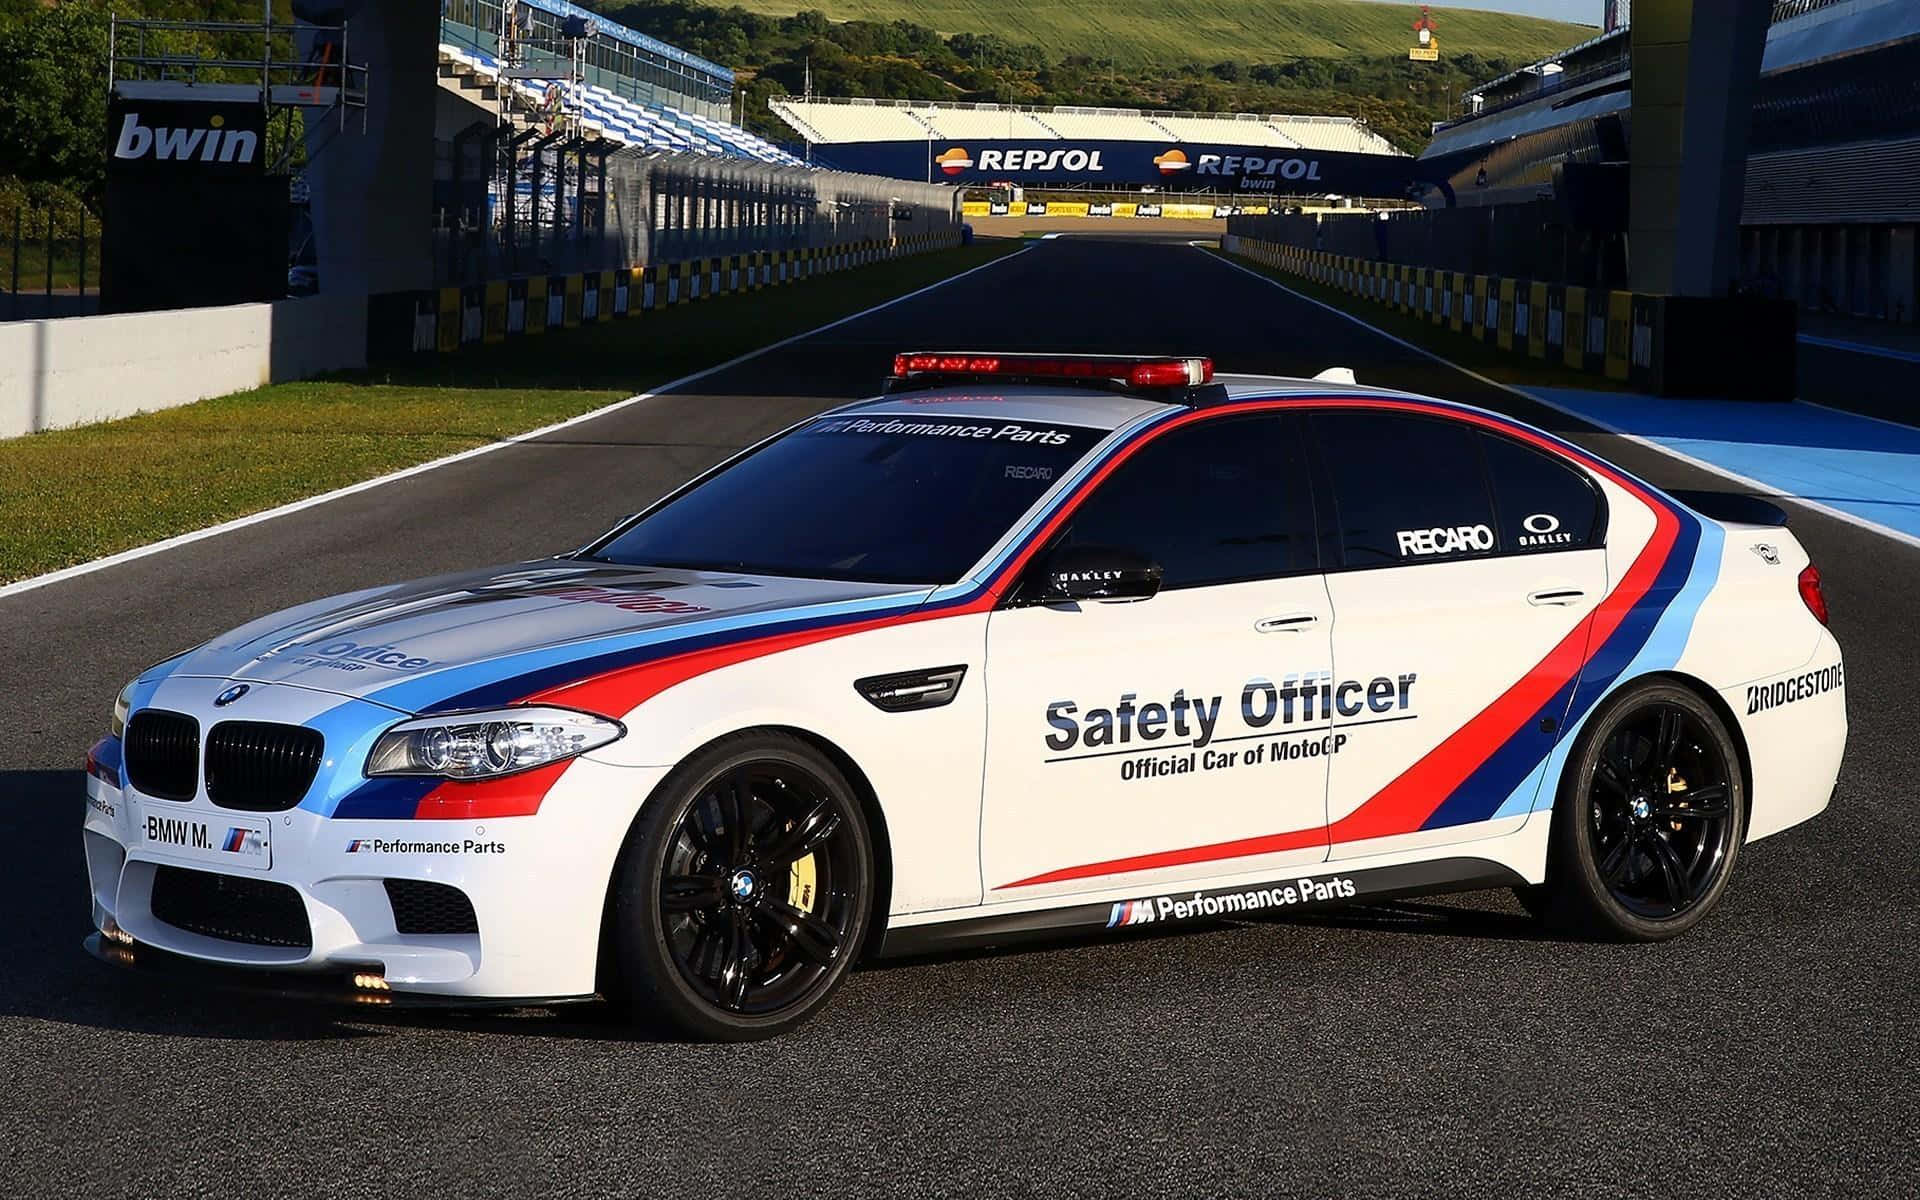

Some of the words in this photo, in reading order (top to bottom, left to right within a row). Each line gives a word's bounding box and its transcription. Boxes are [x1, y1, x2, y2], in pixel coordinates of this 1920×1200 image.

[114, 113, 258, 163] bwin
[978, 150, 1103, 171] REPSOL
[1197, 154, 1321, 180] REPSOL
[1240, 176, 1276, 189] bwin
[842, 418, 992, 438] Performance
[992, 425, 1071, 445] Parts
[1004, 465, 1053, 480] RECARO
[1396, 524, 1494, 556] RECARO
[1519, 532, 1572, 546] OAKLEY
[1059, 571, 1122, 582] OAKLEY
[1747, 662, 1842, 715] BRIDGESTONE
[1045, 688, 1222, 748] Safety
[1240, 670, 1417, 728] Officer
[1120, 753, 1195, 780] Official
[1203, 750, 1238, 771] Car
[1243, 745, 1265, 766] of
[1271, 734, 1347, 762] MotoGP
[147, 815, 188, 845] BMW
[374, 839, 460, 854] Performance
[463, 839, 505, 854] Parts
[1157, 887, 1297, 921] Performance
[1297, 877, 1357, 903] Parts
